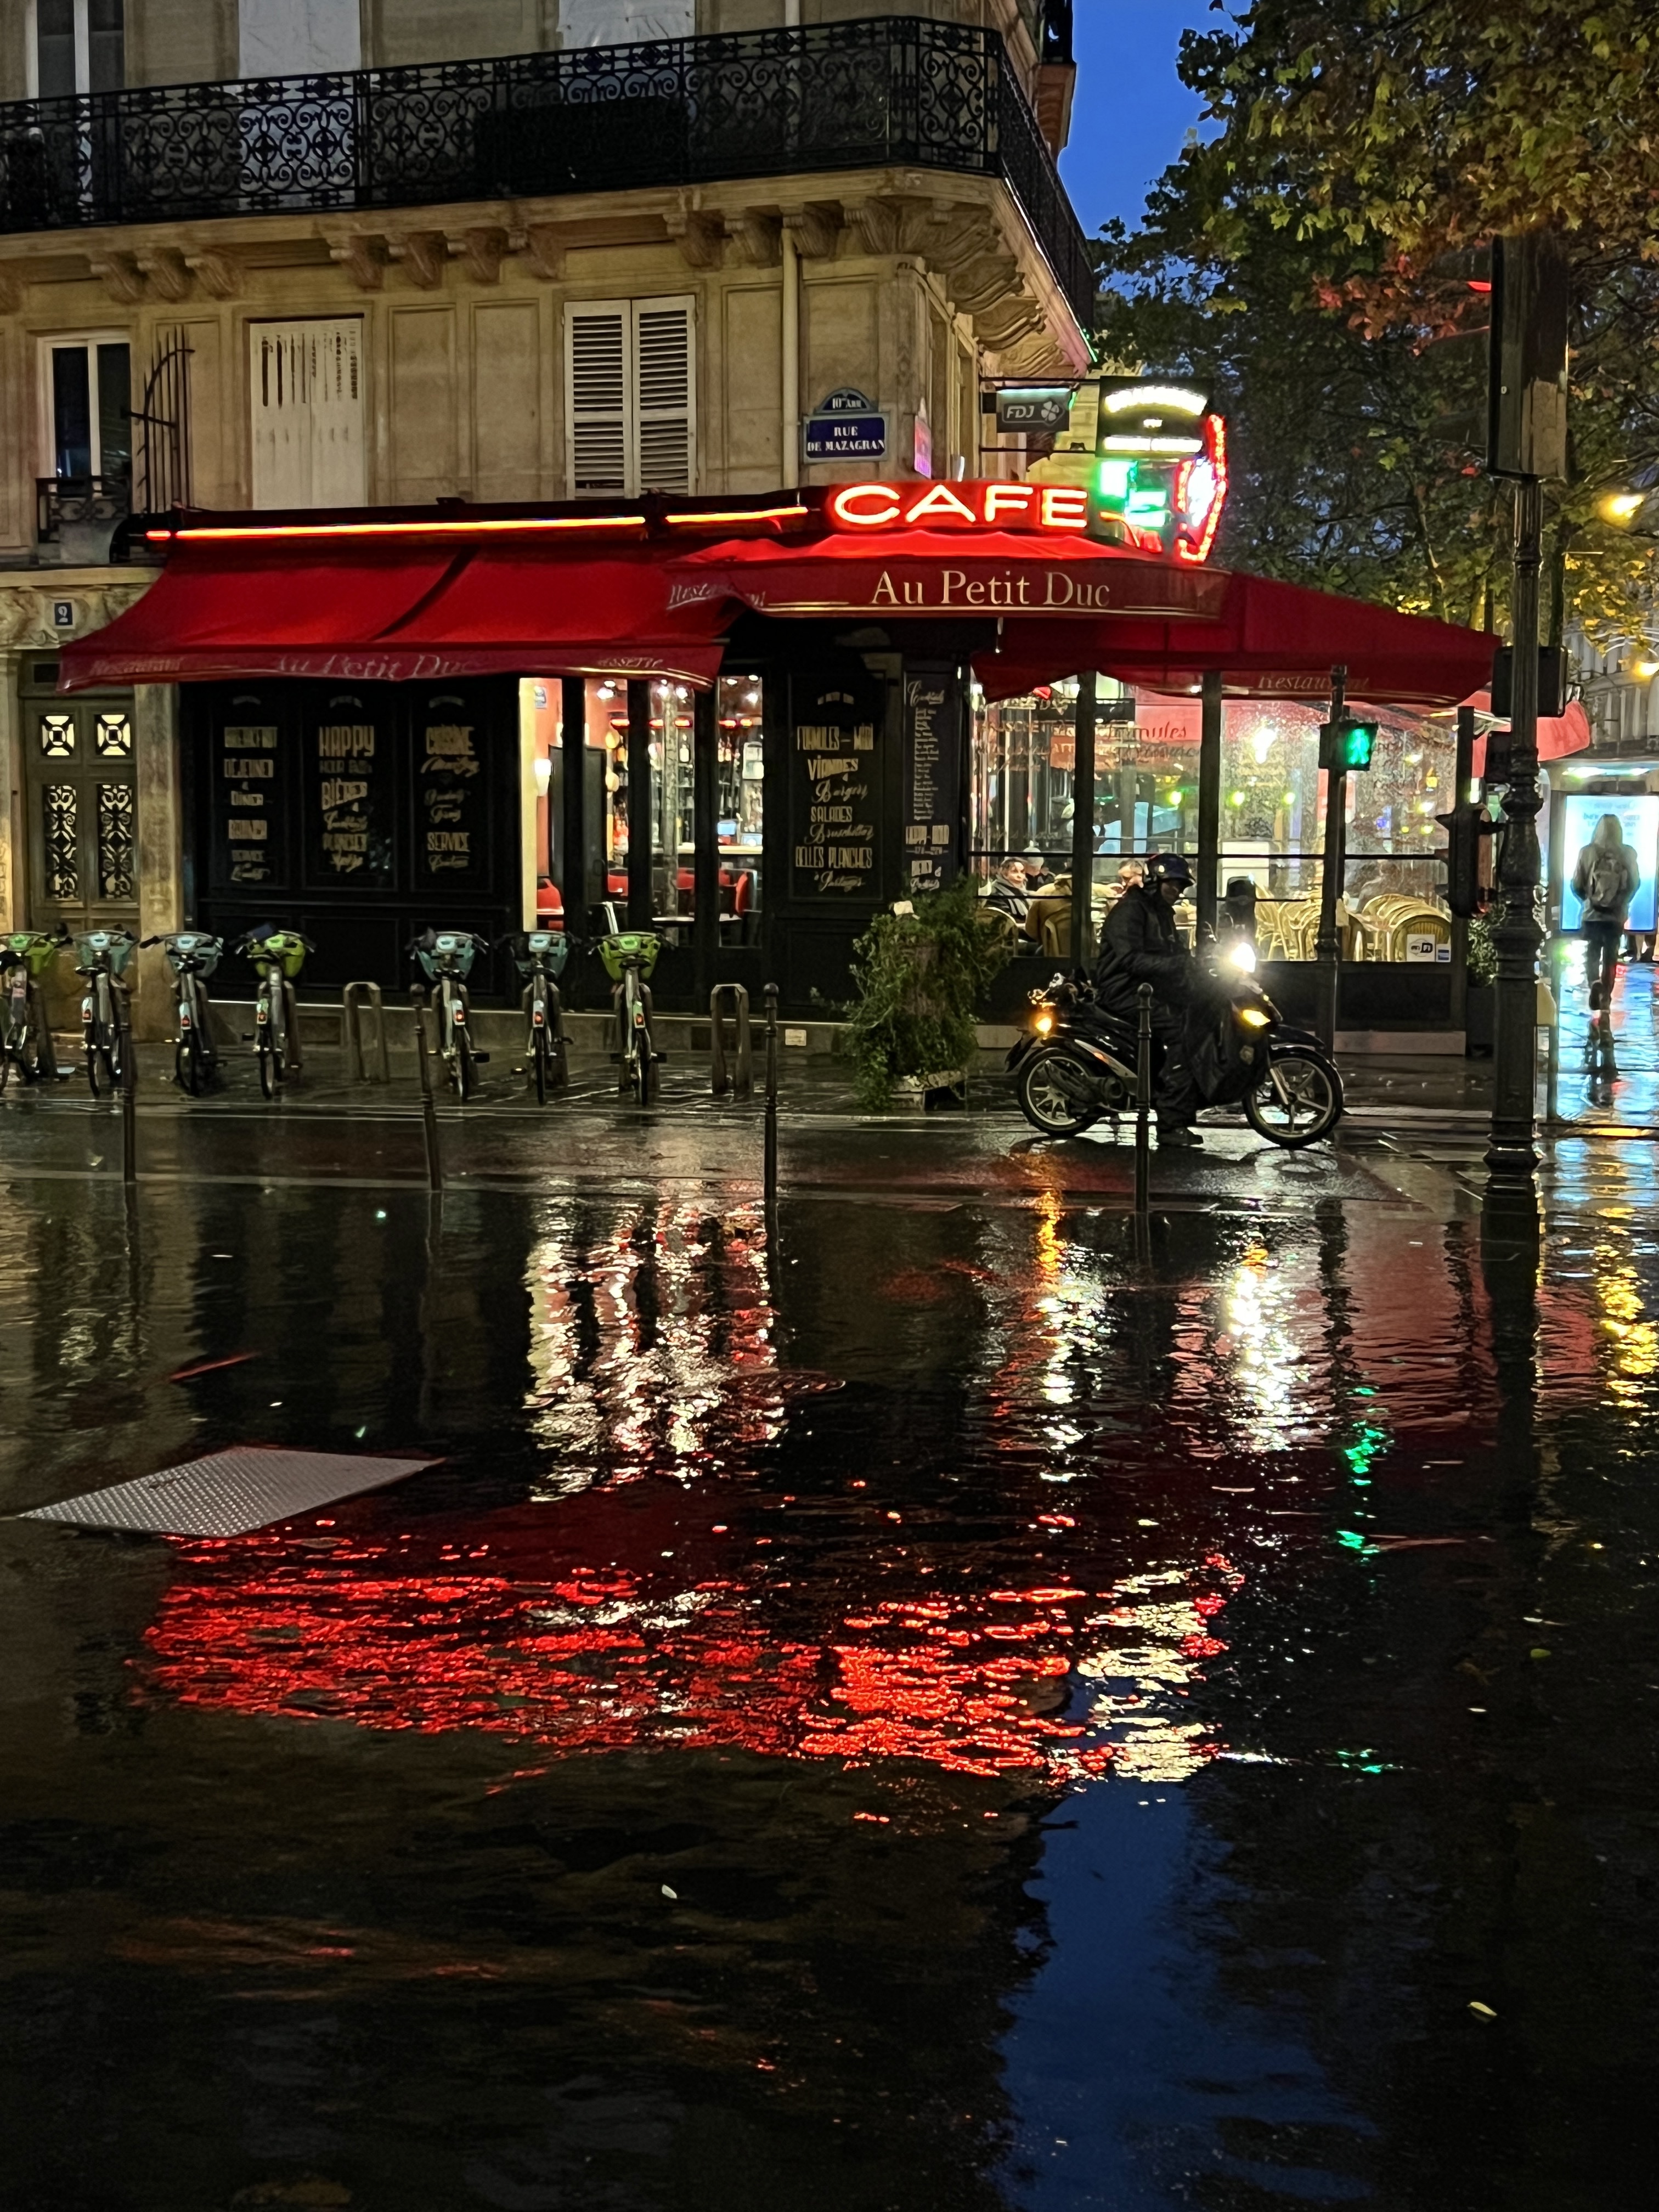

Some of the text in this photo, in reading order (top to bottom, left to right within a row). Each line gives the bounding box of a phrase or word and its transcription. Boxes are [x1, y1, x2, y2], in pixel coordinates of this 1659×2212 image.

[1006, 405, 1035, 419] FDJ
[834, 426, 859, 437] RUE
[807, 439, 885, 452] DE MAZAGRAN
[834, 484, 1088, 528] CAFE
[872, 570, 1110, 607] Au Petit Duc
[58, 606, 69, 623] 2
[319, 726, 374, 757] HAPPY
[810, 806, 853, 822] SALADES
